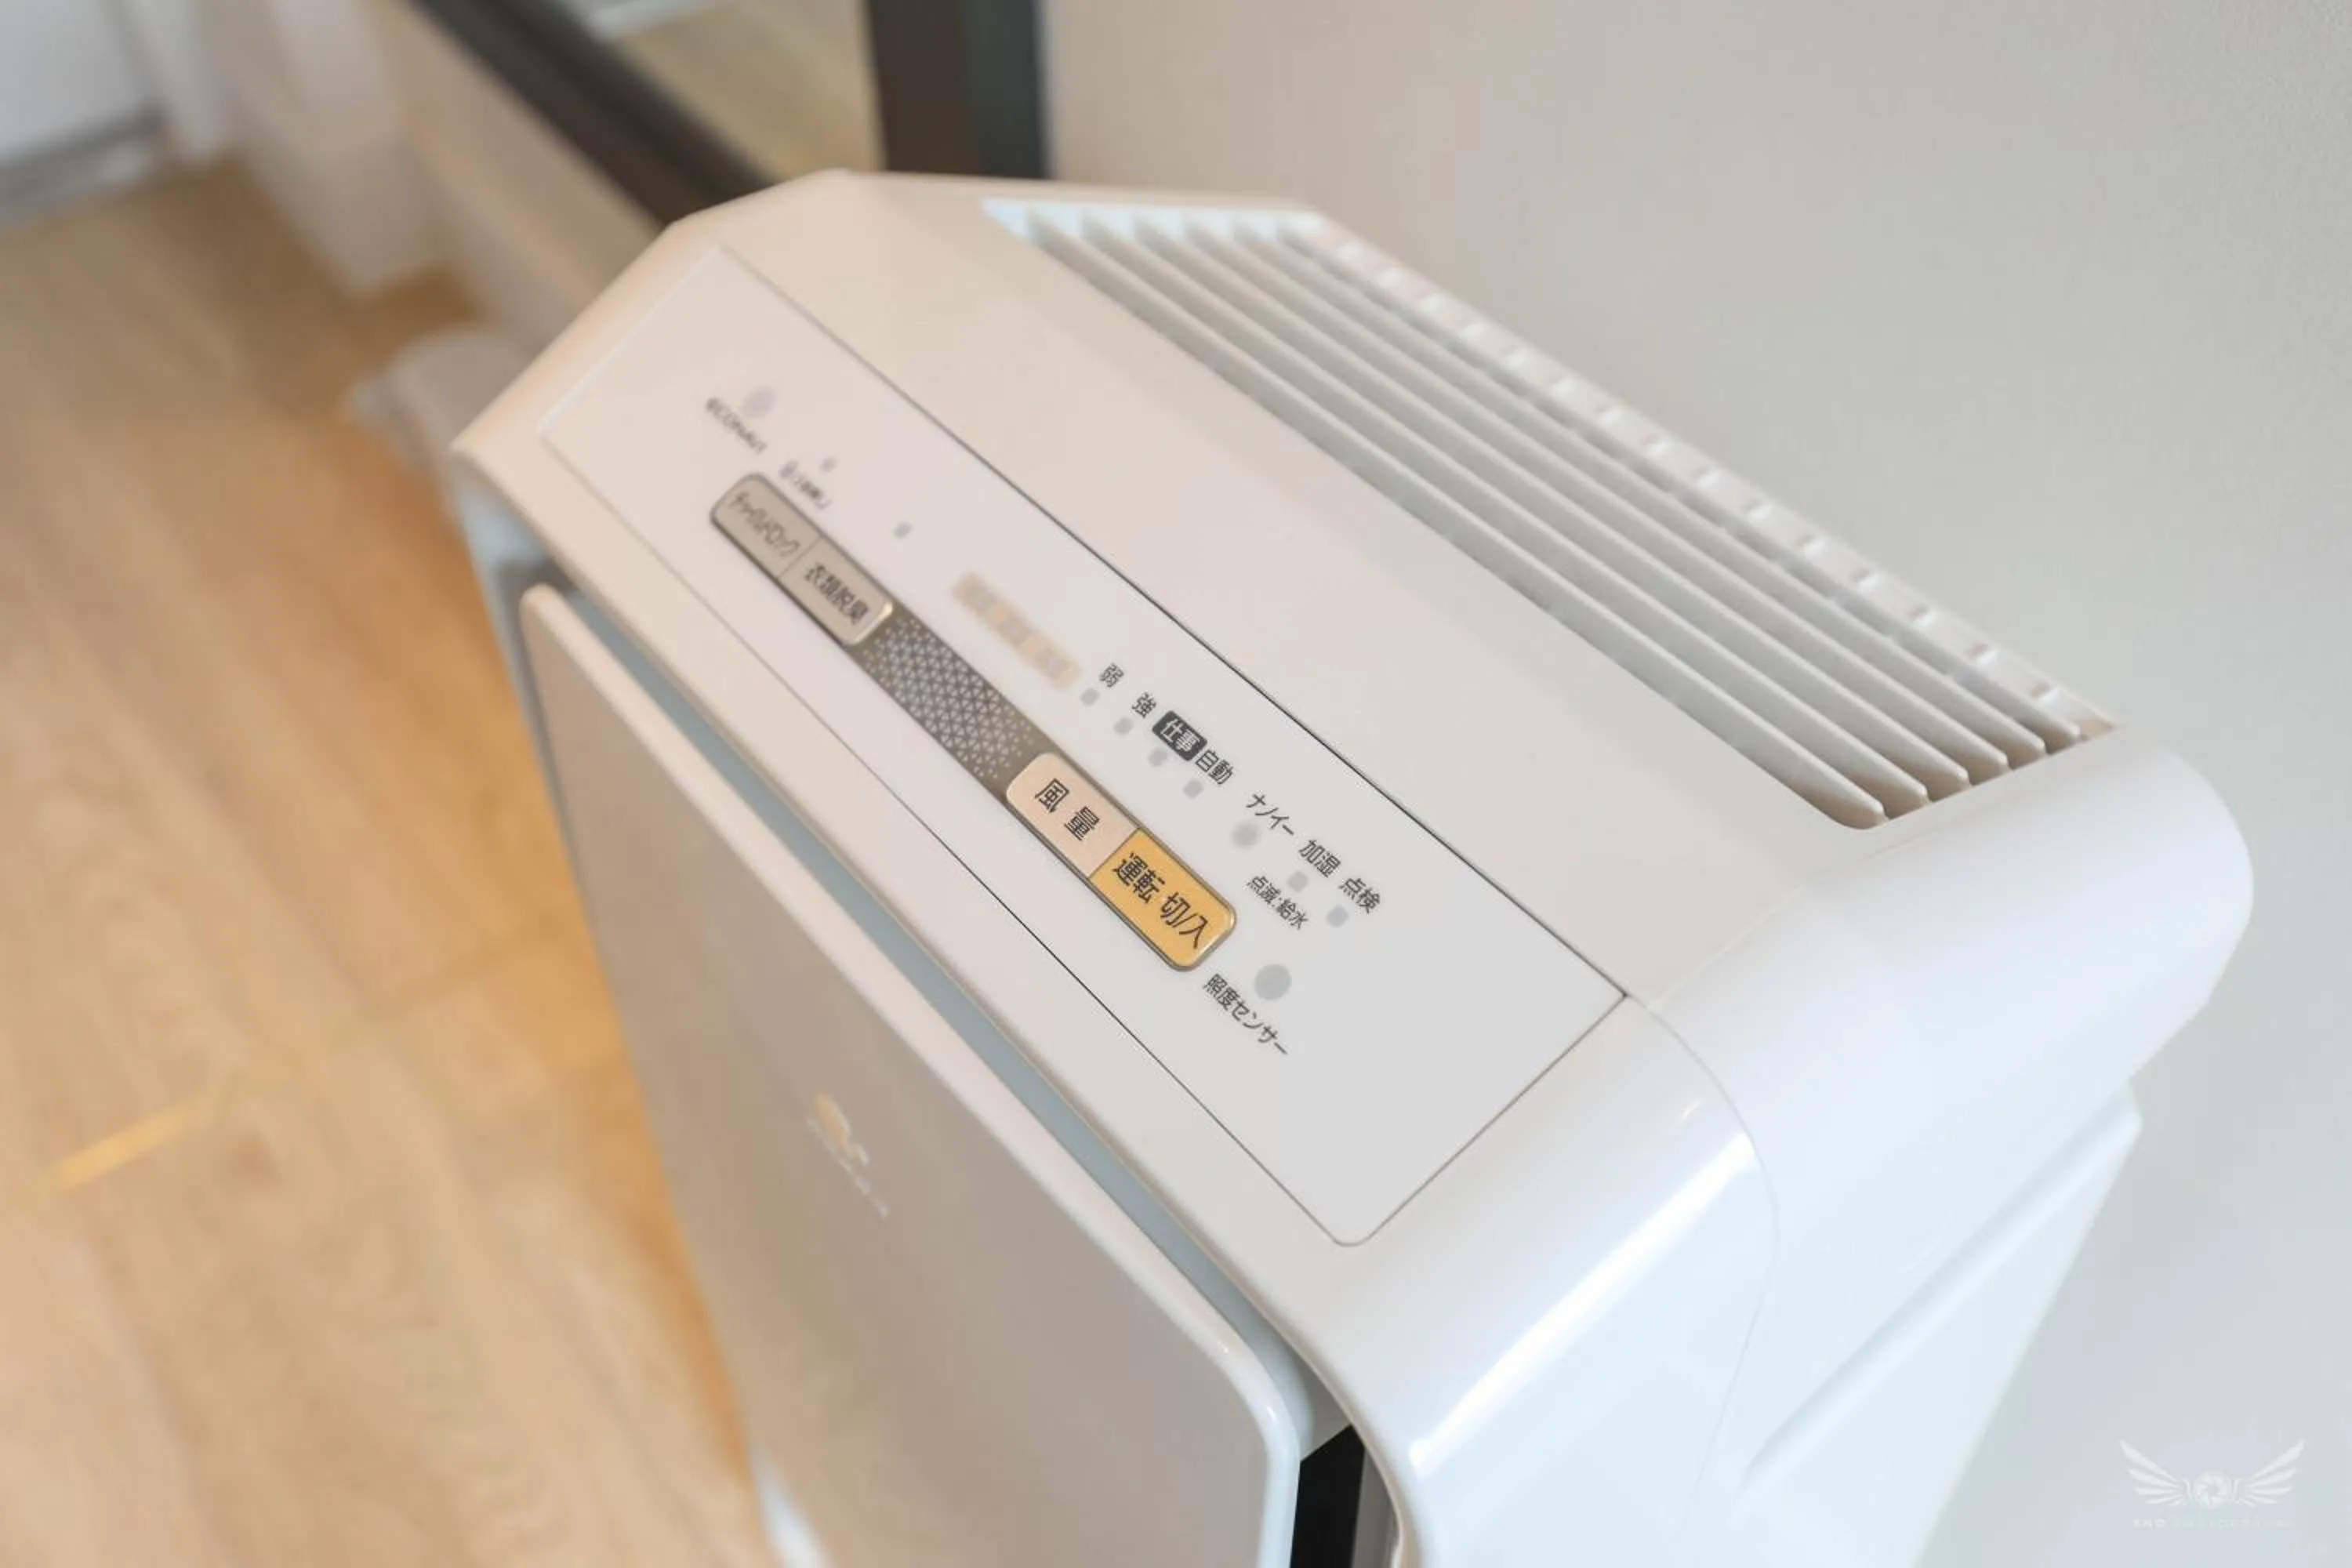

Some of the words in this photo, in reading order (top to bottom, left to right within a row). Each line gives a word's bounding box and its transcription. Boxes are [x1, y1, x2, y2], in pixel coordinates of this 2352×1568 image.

[1099, 662, 1124, 688] 弱
[1131, 692, 1156, 718] 強
[1160, 717, 1201, 753] 仕事
[1195, 750, 1234, 785] 自動
[1246, 793, 1294, 836] ナノイー
[1298, 839, 1341, 878] 加湿
[1338, 877, 1381, 914] 点検
[1202, 973, 1289, 1056] 照度センサー
